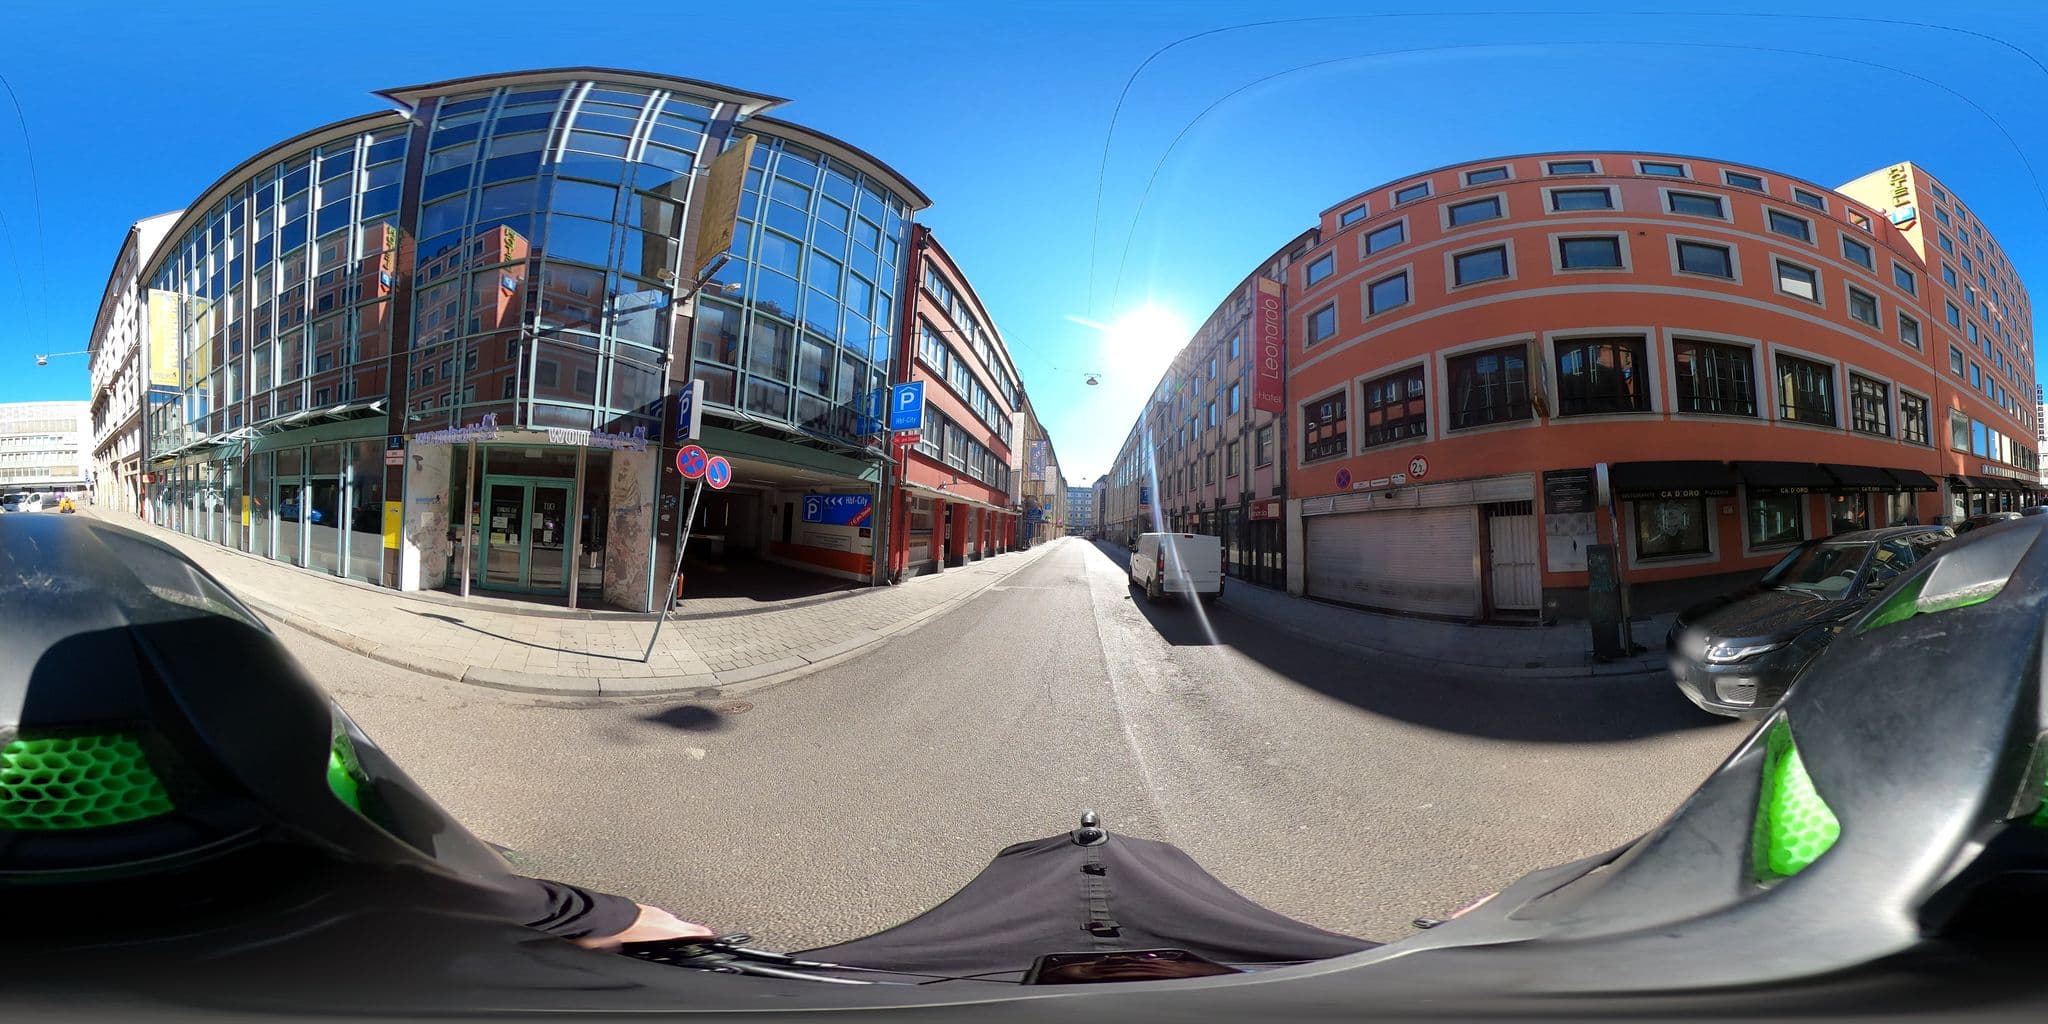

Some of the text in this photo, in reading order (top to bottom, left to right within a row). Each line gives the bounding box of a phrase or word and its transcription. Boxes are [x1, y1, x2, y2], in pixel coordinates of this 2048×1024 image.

[1889, 164, 1911, 208] HOTEL
[1261, 299, 1279, 379] Leonardo
[901, 392, 915, 411] P
[1257, 391, 1281, 404] Hotel
[680, 397, 690, 425] P
[1661, 490, 1673, 498] CA
[807, 503, 818, 520] P
